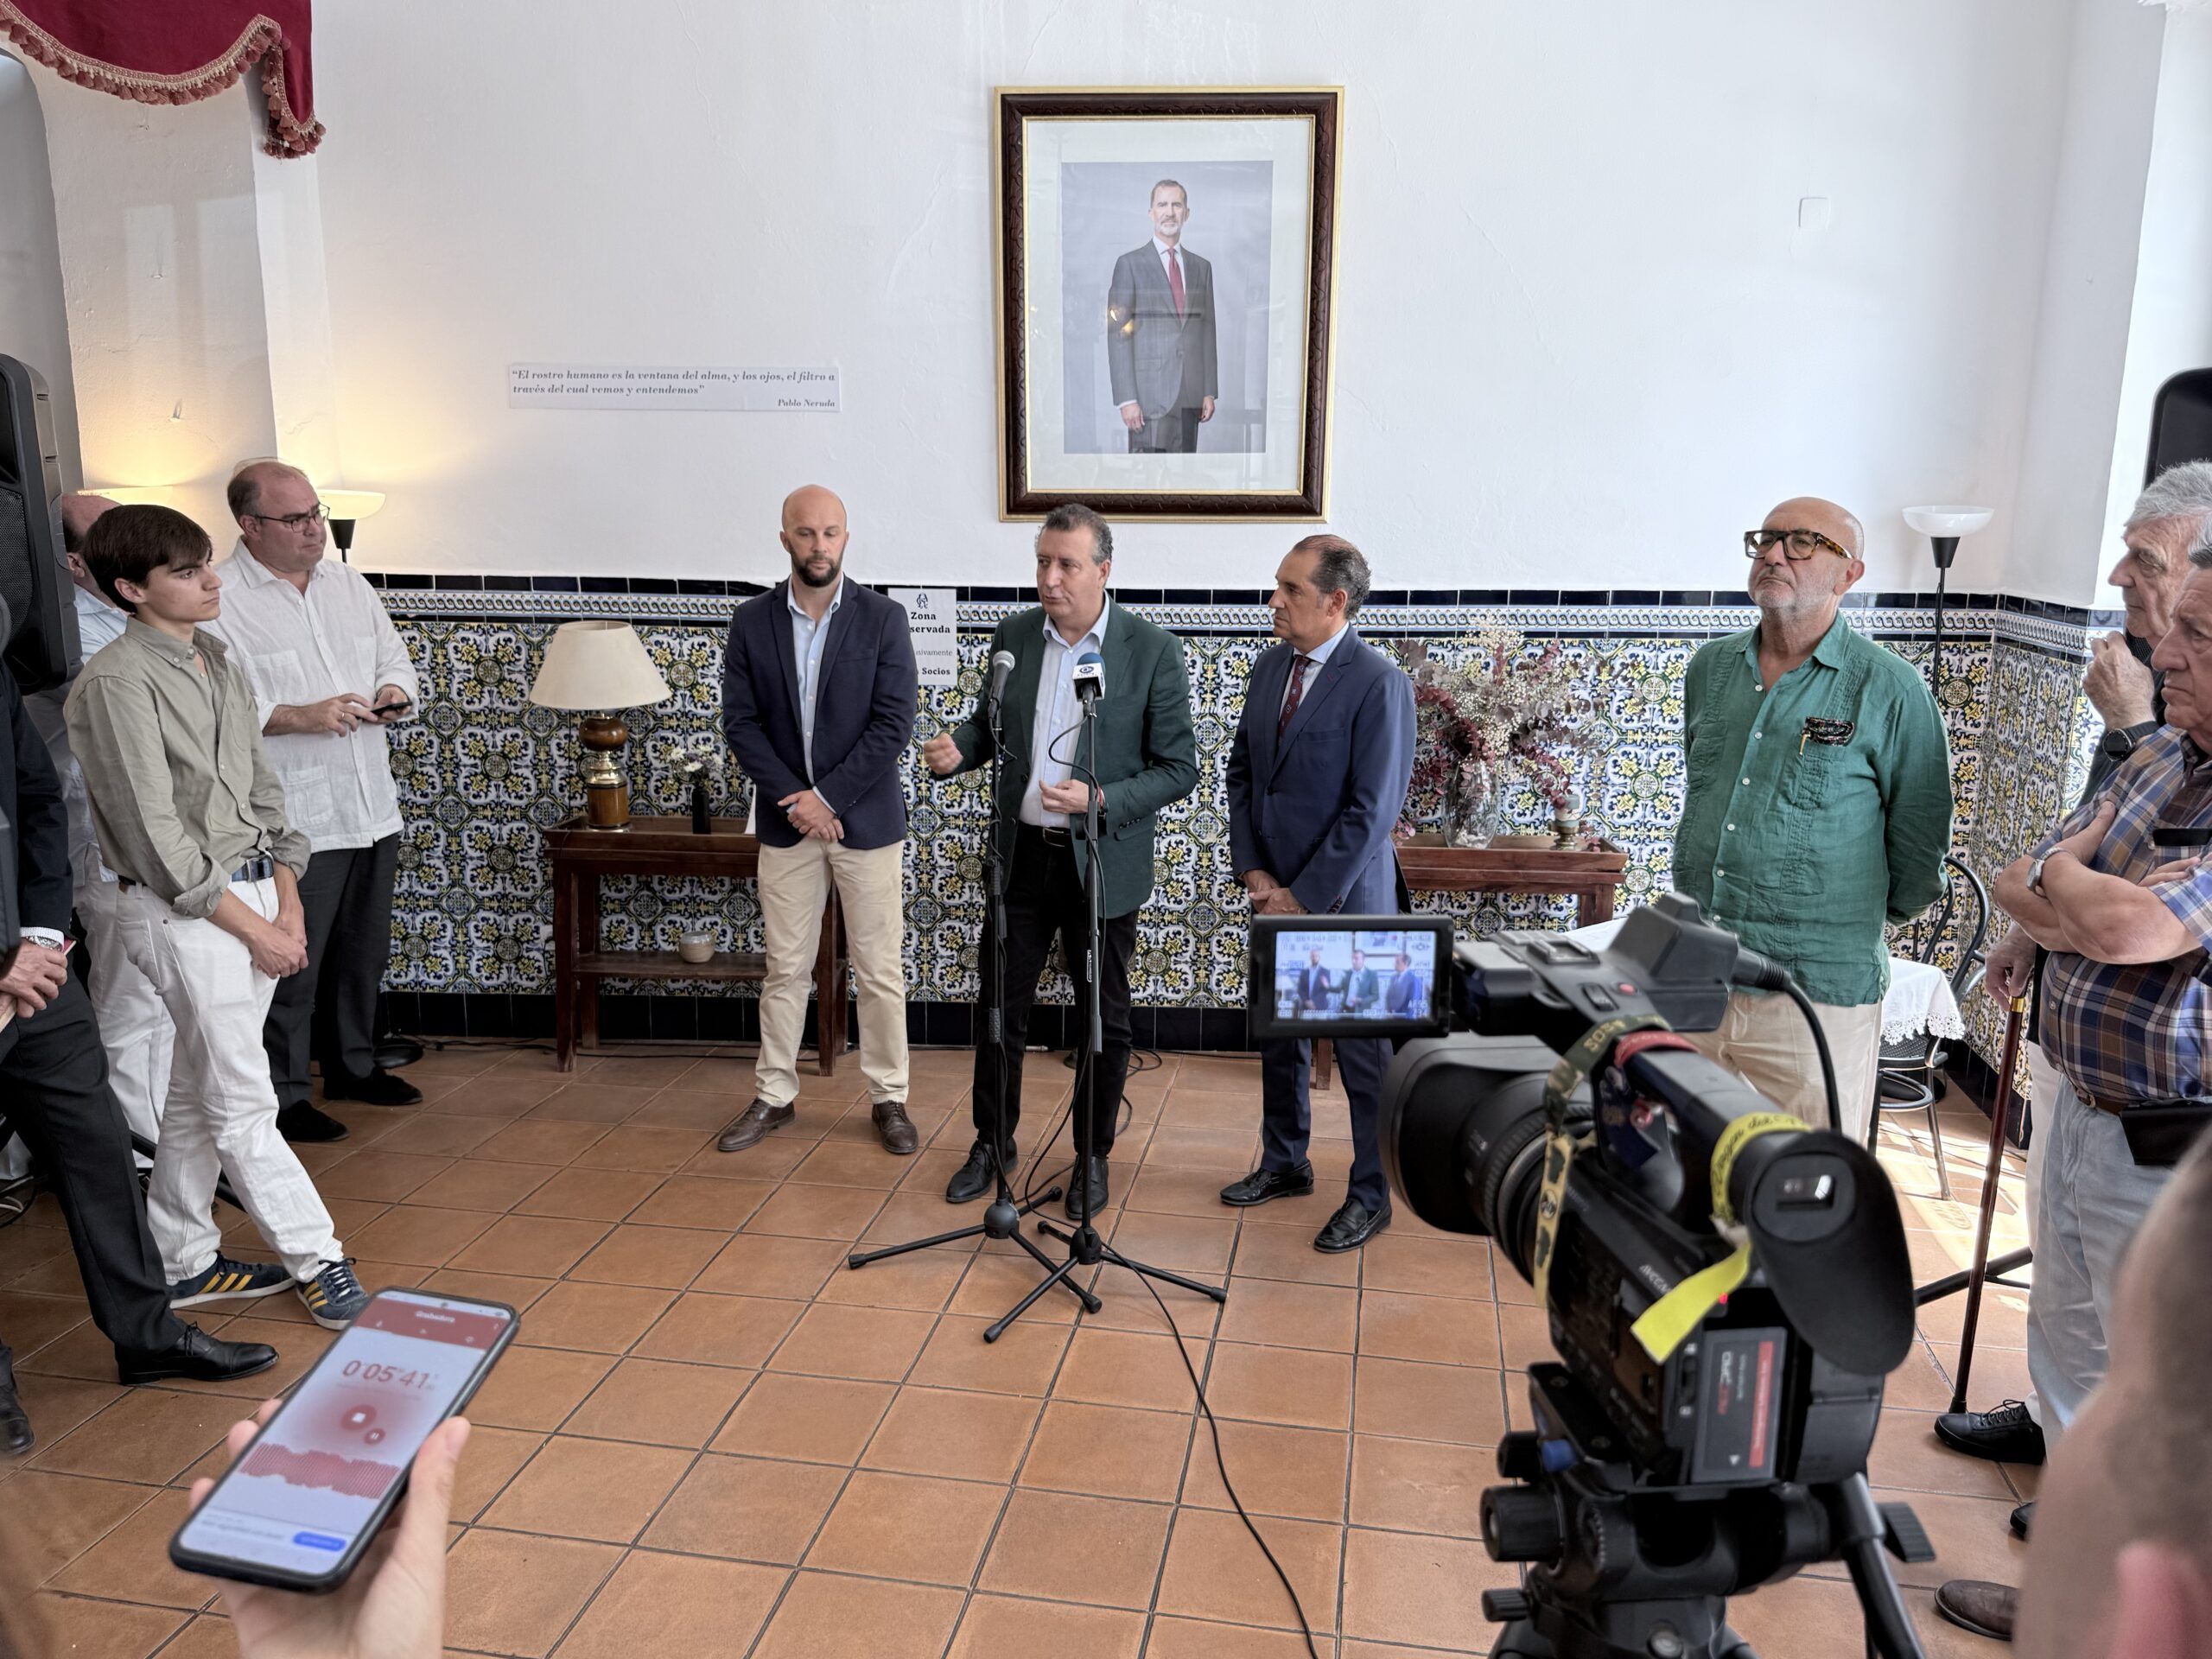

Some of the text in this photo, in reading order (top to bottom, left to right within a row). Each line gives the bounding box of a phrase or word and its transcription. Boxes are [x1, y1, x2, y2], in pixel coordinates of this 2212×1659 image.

[531, 371, 563, 380] rostro
[567, 370, 609, 380] humano
[625, 370, 635, 380] la
[639, 372, 679, 380] ventana
[682, 370, 699, 380] del
[701, 371, 731, 382] alma,
[732, 374, 740, 384] y
[742, 371, 757, 381] los
[760, 371, 785, 384] ojos,
[787, 371, 798, 381] el
[798, 370, 826, 385] filtro
[513, 384, 546, 394] través
[548, 384, 564, 394] del
[567, 384, 589, 394] cual
[626, 386, 634, 397] y
[778, 397, 836, 408] Pablo Neruda
[911, 612, 937, 620] Zona
[910, 625, 950, 633] servada
[922, 667, 950, 676] Socios
